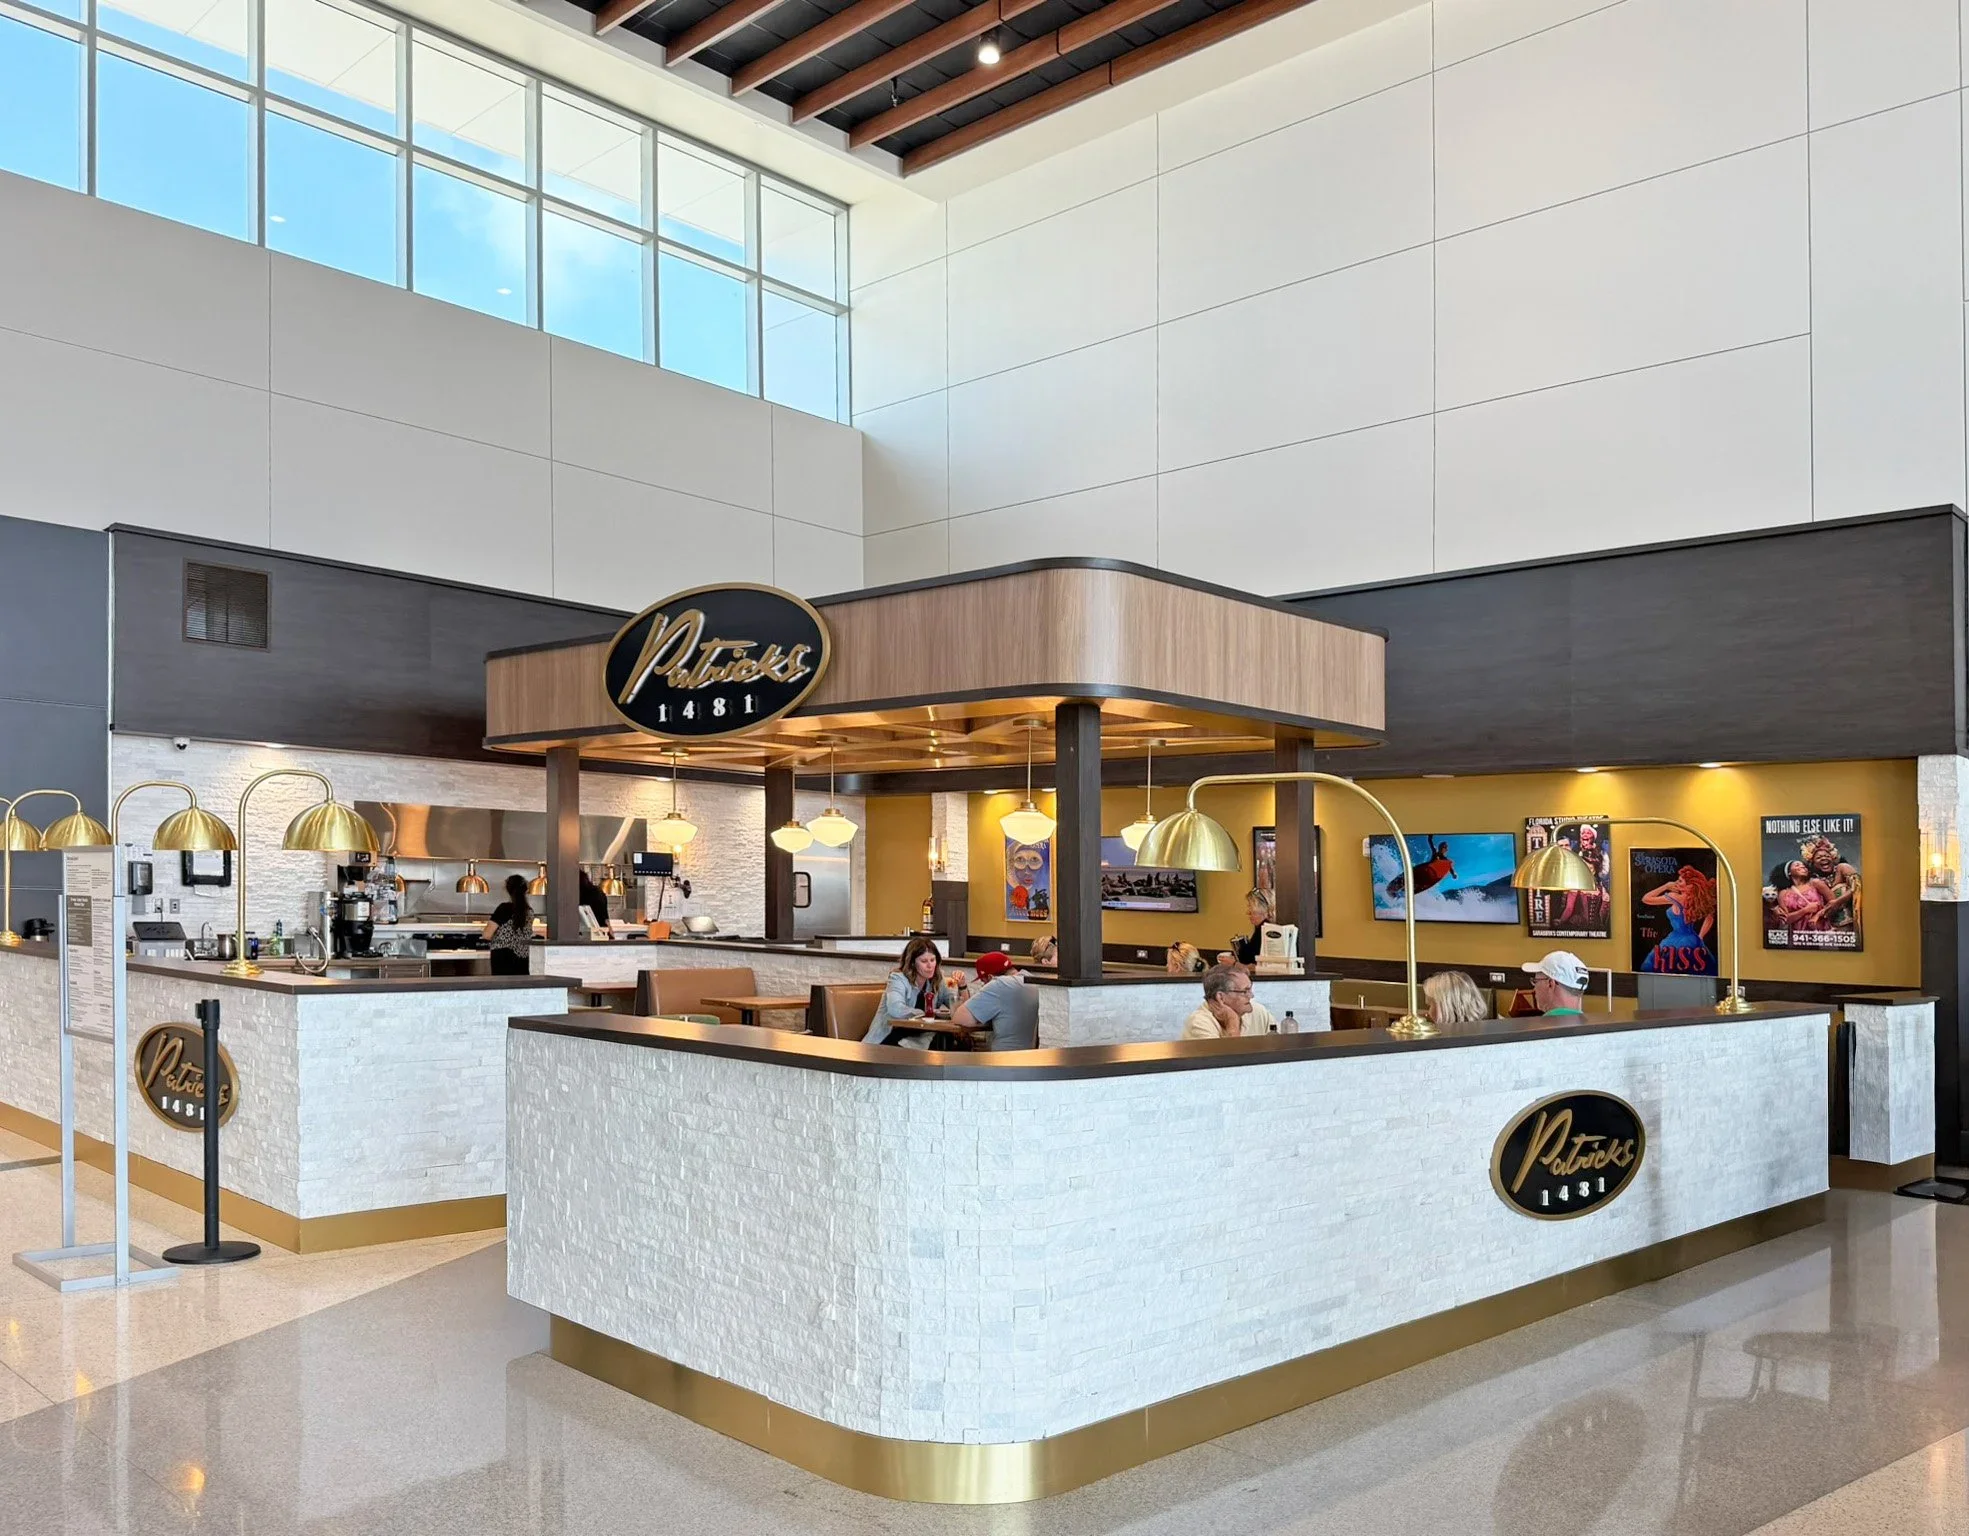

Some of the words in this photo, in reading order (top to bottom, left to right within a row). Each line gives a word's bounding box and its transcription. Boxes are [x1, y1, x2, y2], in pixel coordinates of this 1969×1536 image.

[618, 608, 812, 705] Patricks
[658, 693, 754, 723] 1481
[1528, 818, 1553, 826] FLORIDA
[1766, 820, 1800, 834] NOTHING
[1803, 819, 1821, 833] ELSE
[1823, 819, 1841, 833] LIKE
[1843, 818, 1853, 832] IT!
[1634, 856, 1677, 866] SARASOTA
[1645, 863, 1675, 873] OPERA
[1640, 927, 1658, 938] The
[1793, 934, 1856, 943] 941-366-1505
[1654, 945, 1707, 972] KISS
[145, 1032, 229, 1106] Patrics
[1511, 1108, 1634, 1194] Patricks
[1541, 1177, 1606, 1206] 1481
